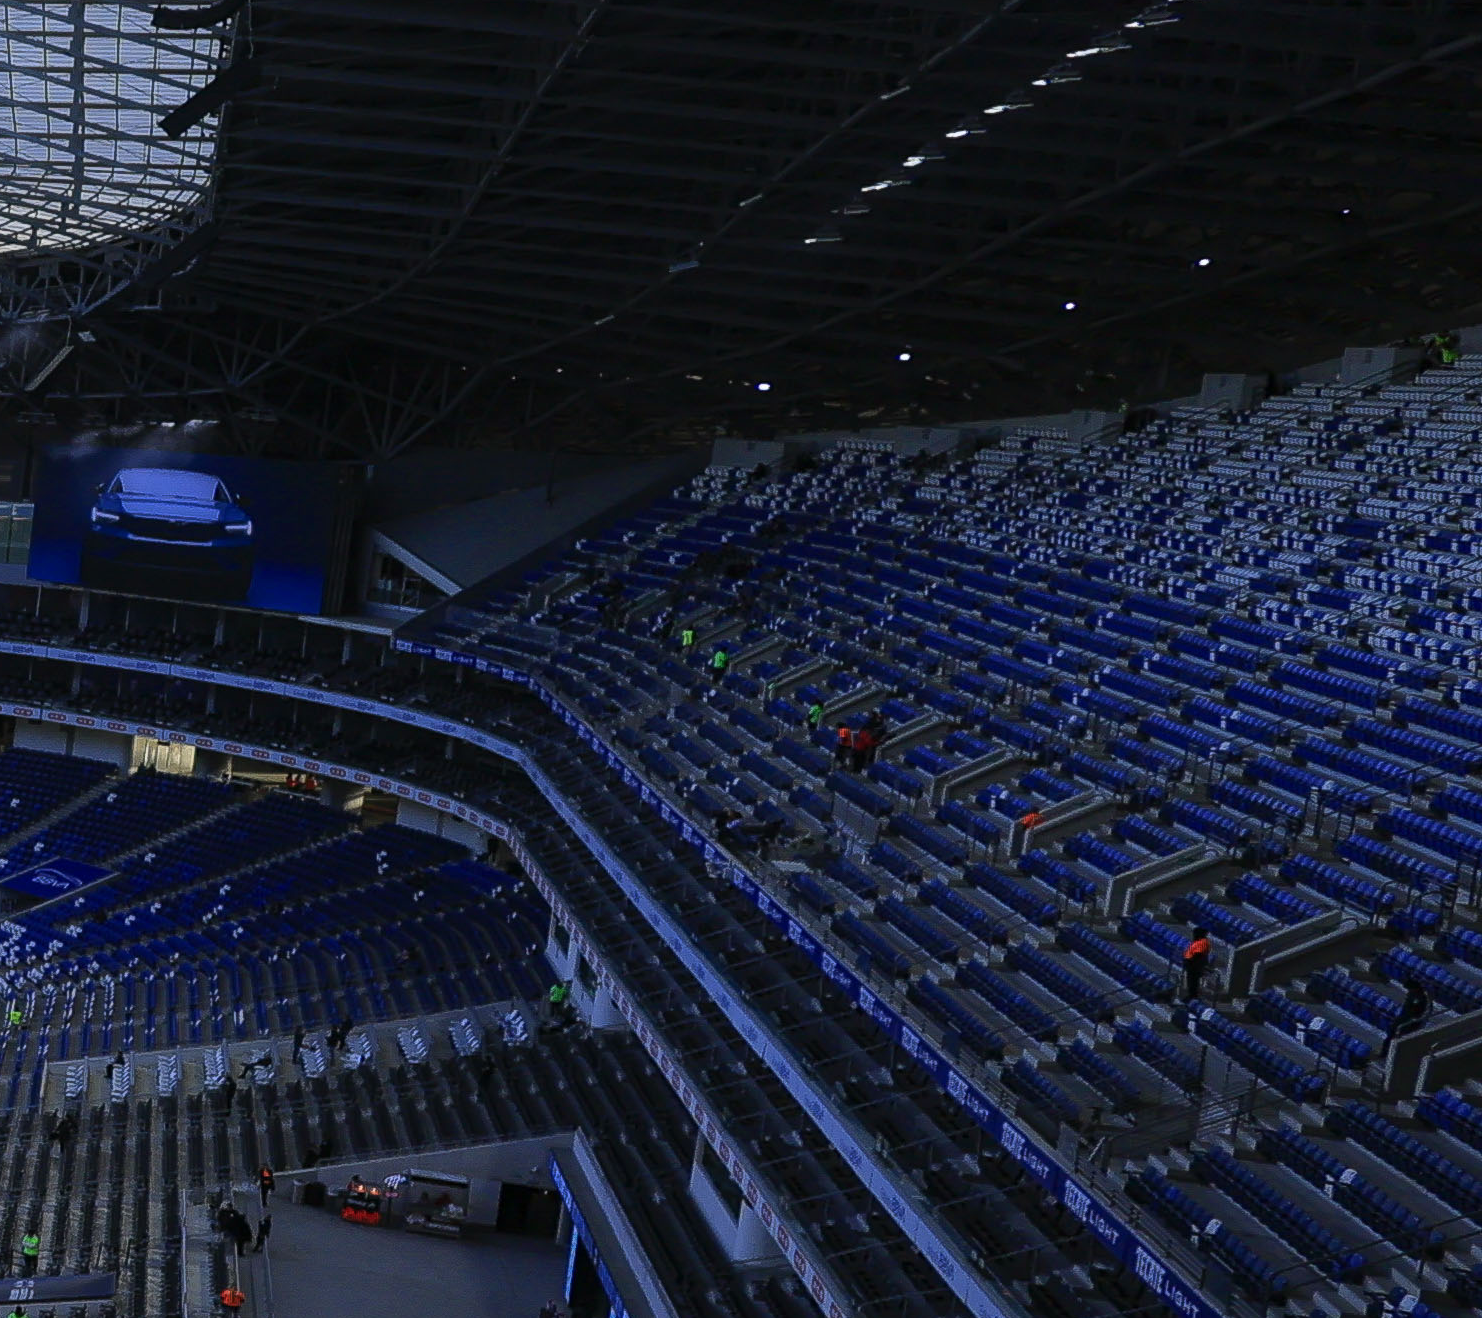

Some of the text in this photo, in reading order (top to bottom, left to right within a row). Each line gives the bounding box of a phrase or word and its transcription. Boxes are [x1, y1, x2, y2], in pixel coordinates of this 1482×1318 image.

[1022, 1144, 1050, 1180] LIGHT
[1063, 1179, 1119, 1245] TECATE LIGHT
[1134, 1245, 1165, 1288] TECATE
